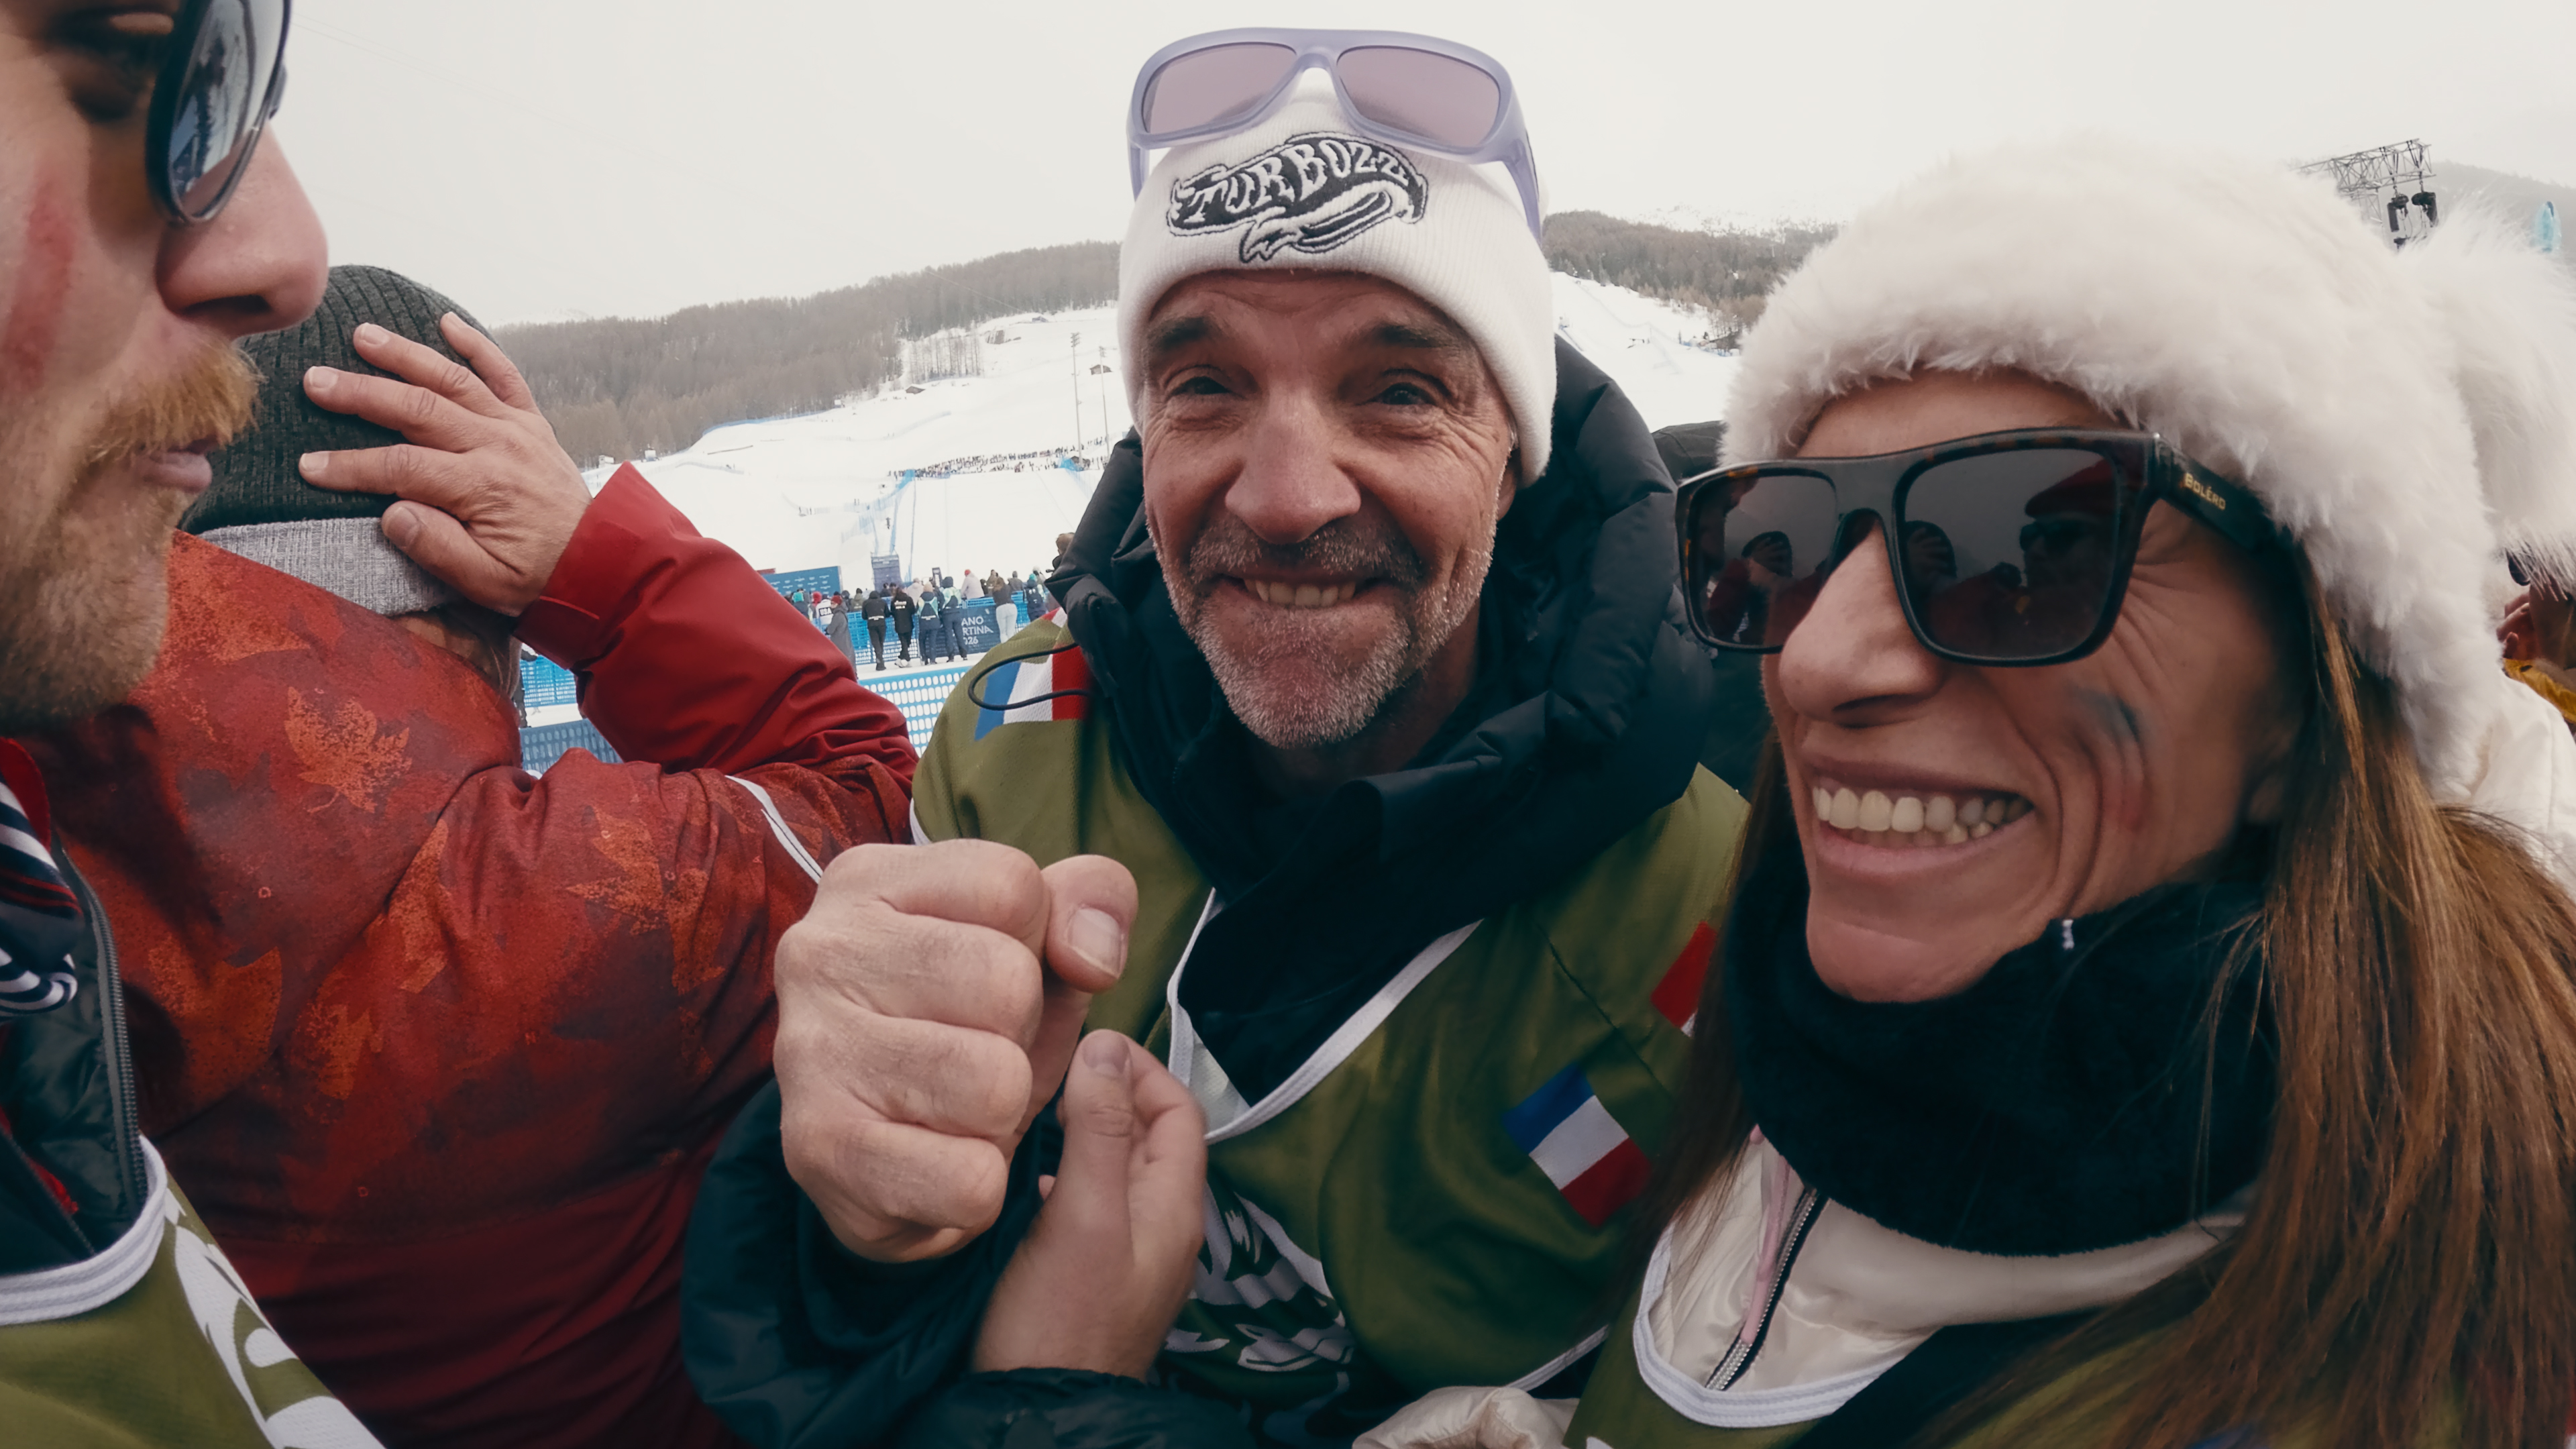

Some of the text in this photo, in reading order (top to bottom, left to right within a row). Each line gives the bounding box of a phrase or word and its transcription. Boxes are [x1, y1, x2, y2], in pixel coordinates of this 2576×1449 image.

[1183, 140, 1409, 224] TURBOZZ
[961, 616, 984, 627] ANO
[962, 625, 994, 636] RTINA
